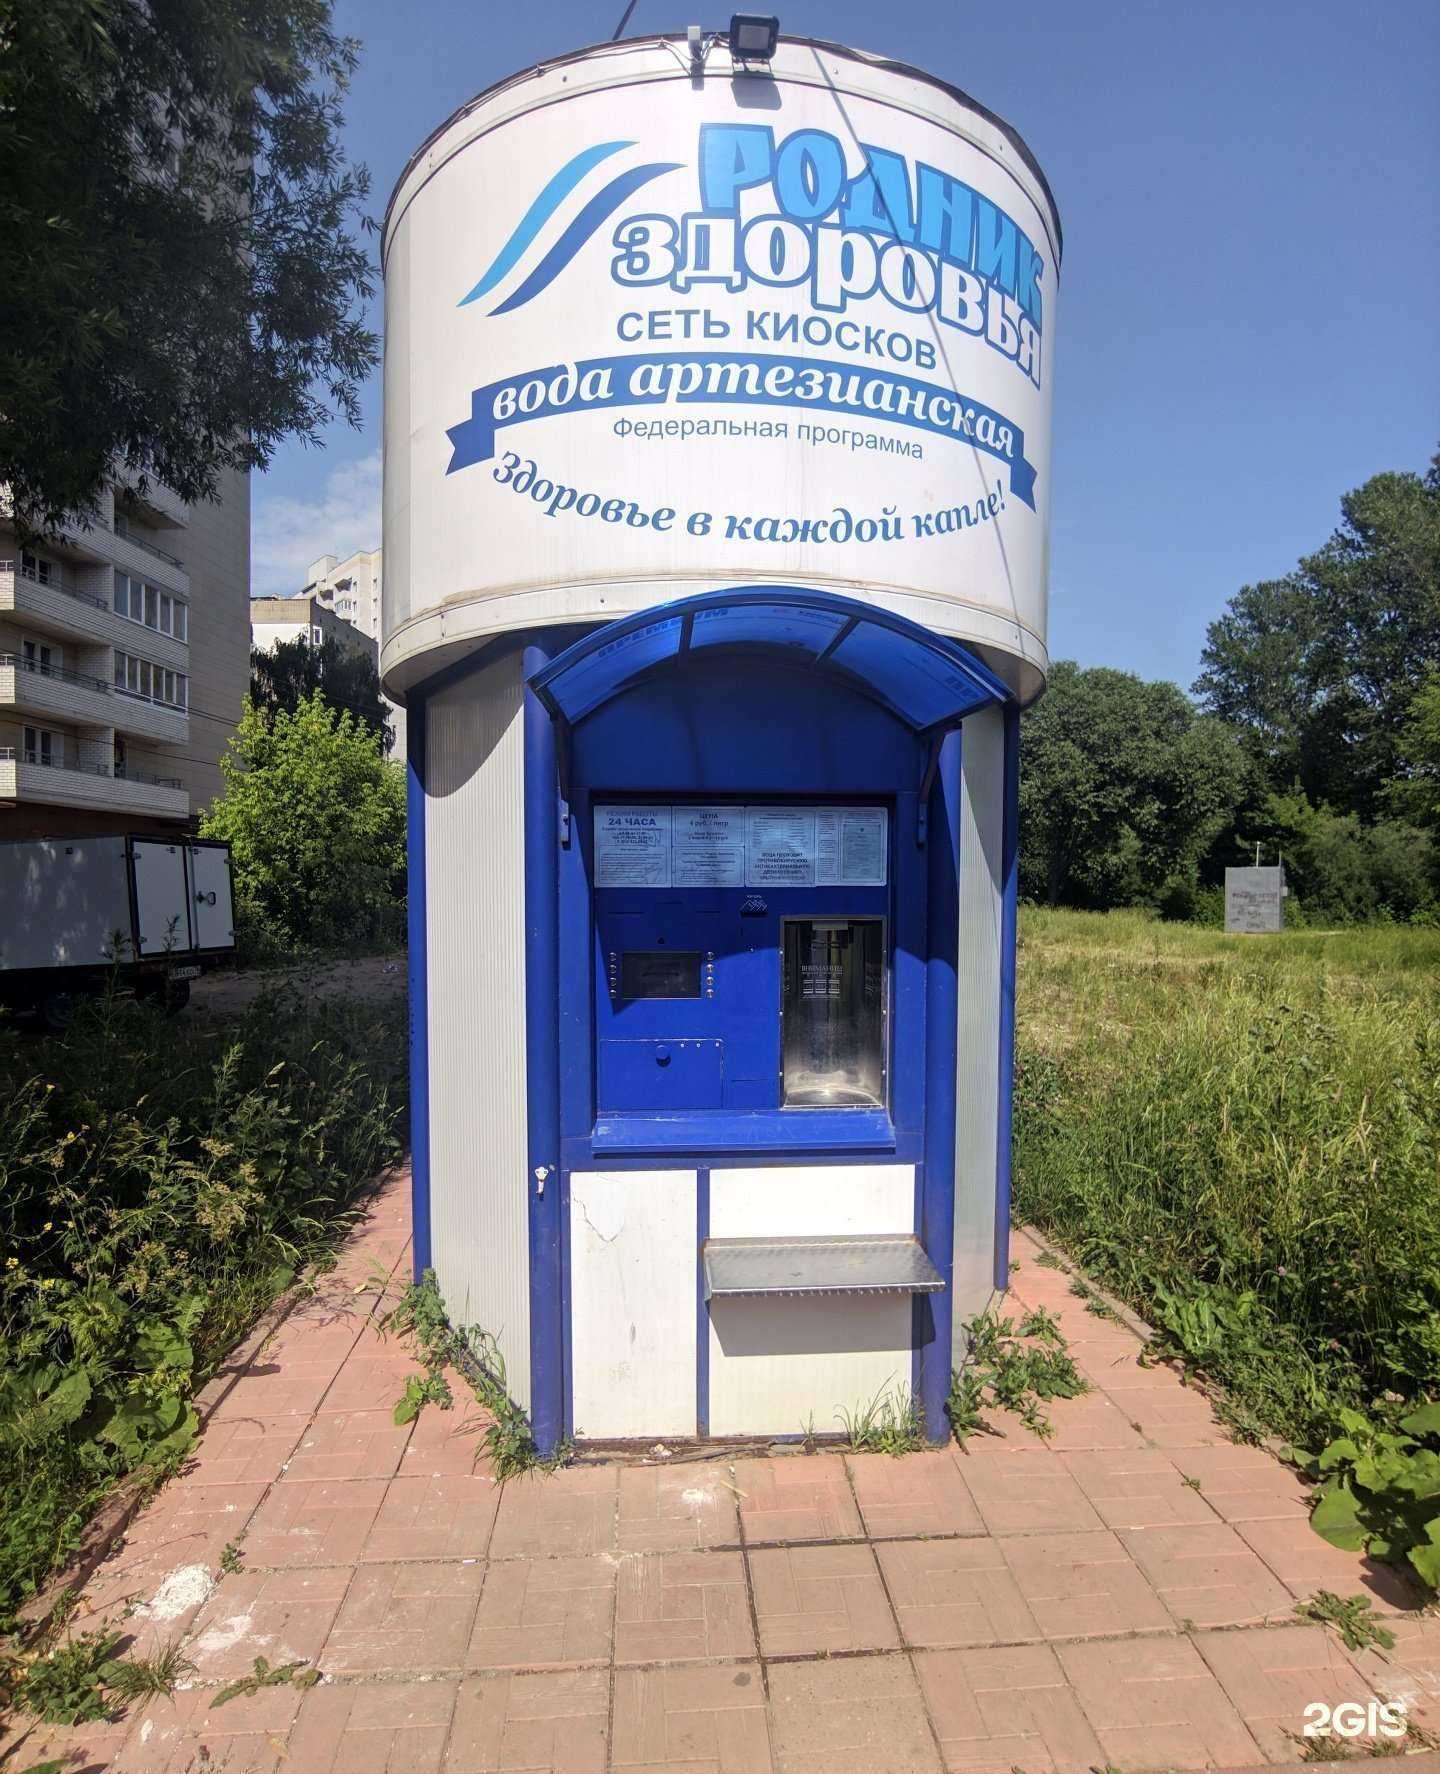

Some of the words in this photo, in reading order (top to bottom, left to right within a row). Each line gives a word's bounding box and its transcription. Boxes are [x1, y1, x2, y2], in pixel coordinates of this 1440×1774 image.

[699, 123, 1043, 327] РОДНИК
[616, 309, 730, 342] СЕТЬ
[747, 310, 937, 370] КИОСКОВ
[492, 361, 613, 420] вода
[628, 358, 1016, 458] артезианская
[613, 416, 788, 440] Федеральная
[797, 422, 924, 459] программа
[492, 449, 676, 531] Здоровье
[687, 508, 712, 537] в
[724, 507, 905, 544] каждой
[911, 478, 1007, 538] капле!
[608, 818, 621, 826] 24
[625, 818, 656, 826] ЧАСА
